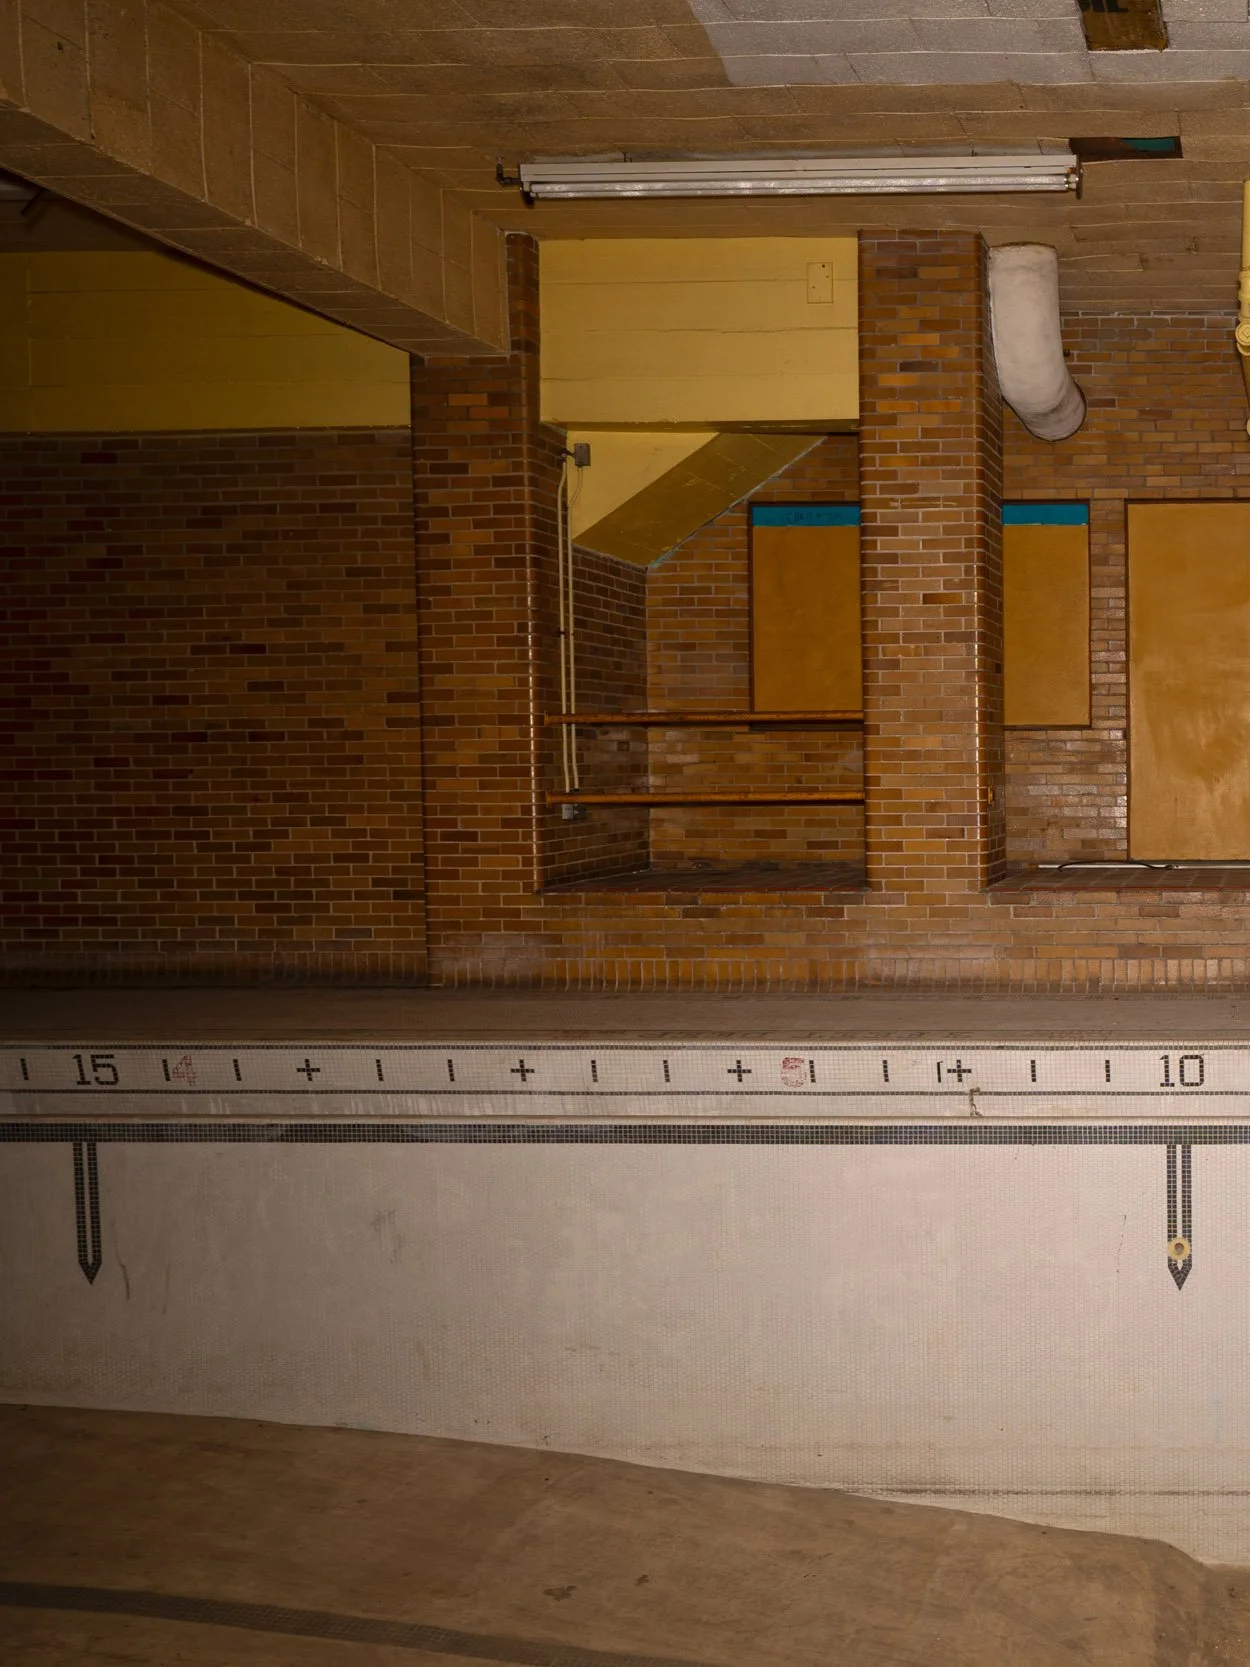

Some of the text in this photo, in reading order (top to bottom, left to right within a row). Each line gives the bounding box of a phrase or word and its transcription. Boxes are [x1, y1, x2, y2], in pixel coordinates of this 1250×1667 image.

[72, 1054, 119, 1085] 15
[172, 1055, 197, 1086] 4
[781, 1057, 807, 1088] 5
[1160, 1054, 1204, 1087] 10
